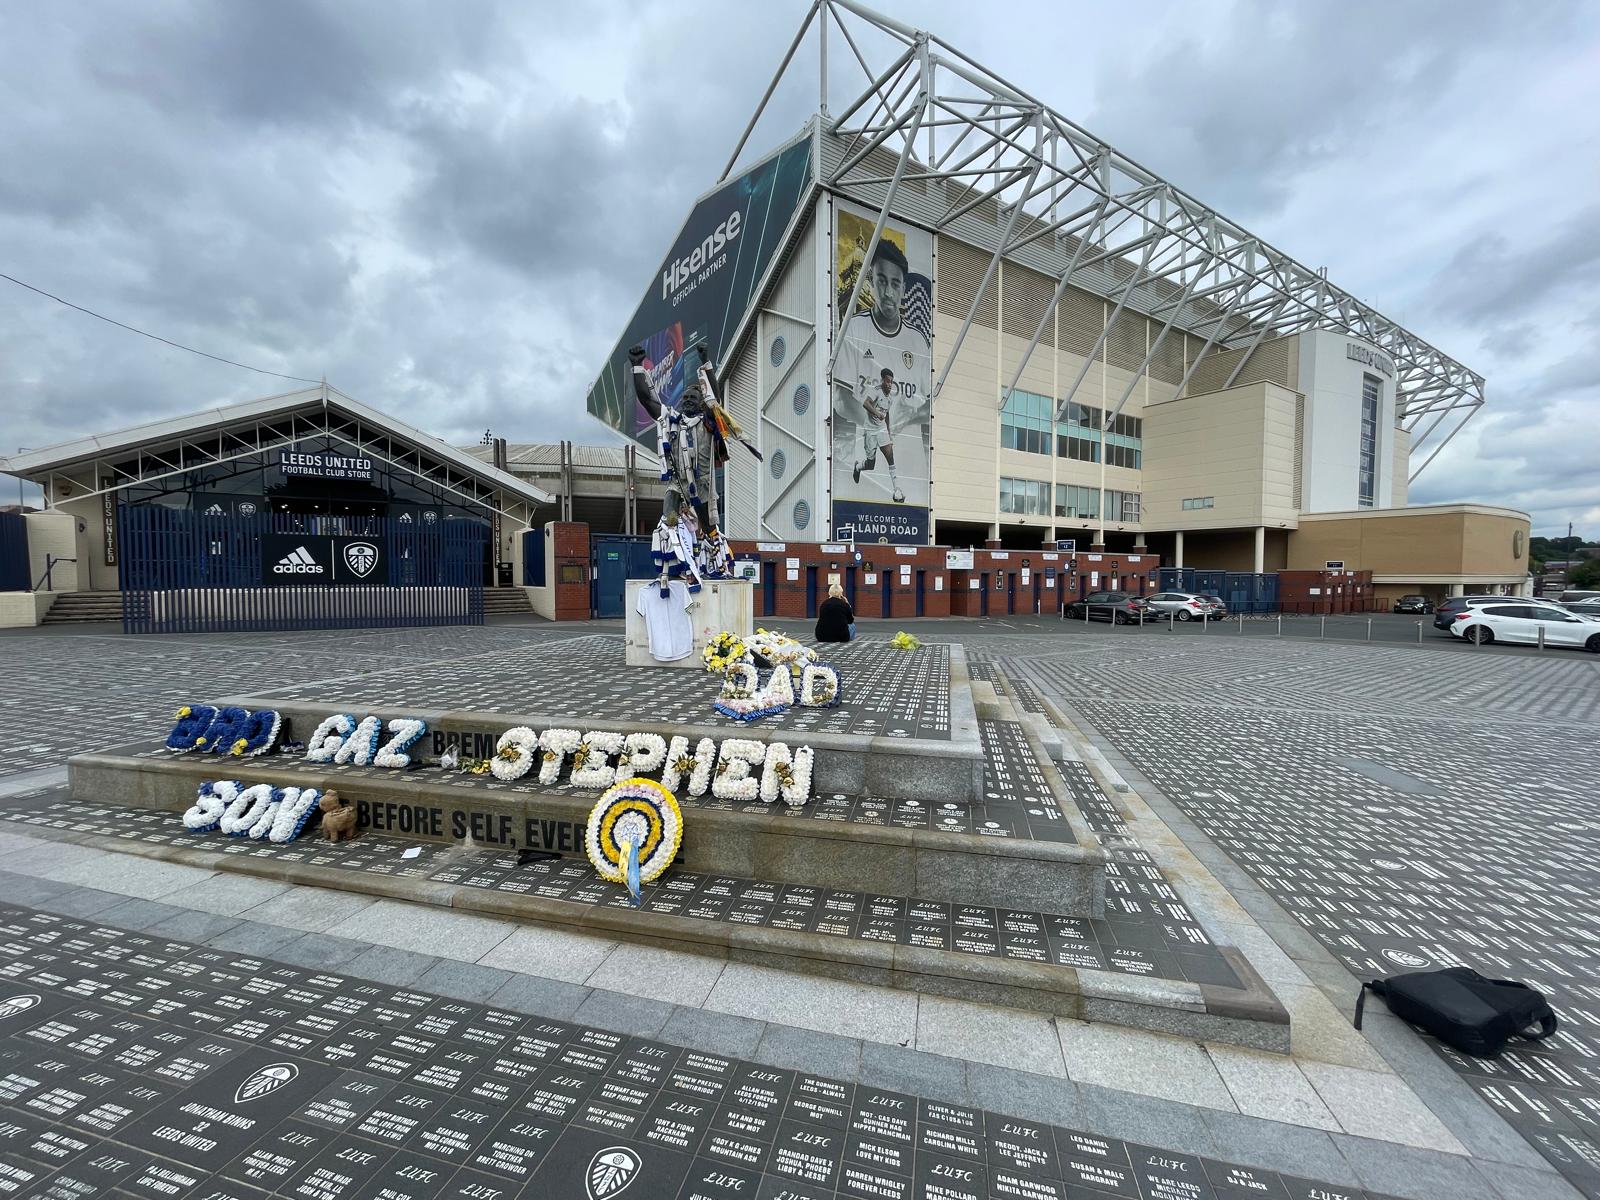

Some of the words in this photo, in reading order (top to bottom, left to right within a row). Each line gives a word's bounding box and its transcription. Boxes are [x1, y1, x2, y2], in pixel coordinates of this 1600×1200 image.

[662, 210, 741, 301] Hisense
[672, 279, 697, 307] OFFICIAL
[698, 253, 727, 285] PARTNER
[281, 453, 322, 466] LEEDS
[325, 456, 371, 470] UNITED
[282, 465, 323, 476] FOOTBALL
[325, 468, 345, 477] CLUB
[347, 470, 371, 479] STORE
[858, 514, 896, 524] WELCOME
[898, 516, 908, 524] TO
[890, 526, 918, 536] ROAD
[105, 518, 114, 563] UNITED
[273, 563, 324, 574] adidas
[306, 713, 427, 768] GAZ
[433, 730, 501, 759] BREM
[490, 726, 815, 806] STEPHEN
[183, 780, 322, 844] SON
[357, 800, 443, 837] BEFORE
[452, 810, 516, 849] SELF,
[636, 1046, 669, 1059] LUFC
[688, 1053, 704, 1062] DAVID
[703, 1057, 729, 1067] PRESTON
[626, 1059, 648, 1070] STUART
[550, 1075, 586, 1089] LUFC
[672, 1073, 699, 1084] ANDREW
[697, 1078, 723, 1090] PRESTON
[747, 1070, 783, 1084] LUFC
[533, 1089, 552, 1099] LEEDS
[549, 1093, 577, 1105] FOREVER
[603, 1083, 632, 1095] STEWART
[733, 1089, 753, 1099] LEEDS
[752, 1093, 778, 1104] FOREVER
[741, 1085, 760, 1094] ALLAN
[759, 1089, 775, 1097] KING
[822, 1089, 846, 1099] ALWAYS
[600, 1090, 616, 1100] KEEP
[614, 1094, 643, 1105] FIGHTING
[793, 1100, 817, 1111] GEORGE
[868, 1095, 905, 1110] LUFC
[179, 1102, 228, 1122] JONATHAN
[450, 1108, 489, 1124] LUFC
[587, 1106, 607, 1117] MICKY
[604, 1111, 636, 1123] JOHNSON
[665, 1101, 704, 1117] LUFC
[809, 1111, 824, 1119] MOT
[956, 1110, 974, 1119] JULIE
[585, 1114, 602, 1124] LUFC
[600, 1118, 613, 1126] FOR
[611, 1121, 627, 1130] LIFE
[654, 1117, 671, 1127] TONY
[676, 1123, 696, 1133] FIONA
[727, 1112, 741, 1120] RAY
[739, 1115, 753, 1123] AND
[753, 1118, 767, 1127] SUE
[727, 1120, 746, 1130] ALAW
[745, 1125, 761, 1133] MOT
[853, 1121, 876, 1133] KIPPER
[152, 1125, 186, 1142] LEEDS
[180, 1133, 217, 1152] UNITED
[509, 1123, 549, 1139] LUFC
[646, 1130, 662, 1139] MOT
[659, 1134, 689, 1147] FOREVER
[655, 1125, 687, 1138] RACKHAM
[926, 1129, 954, 1141] RICHARD
[955, 1136, 976, 1146] MILLS
[1000, 1123, 1040, 1139] LUFC
[791, 1131, 832, 1148] LUFC
[923, 1137, 956, 1151] CAROLINA
[957, 1145, 979, 1156] WHITE
[1084, 1138, 1110, 1149] DANIEL
[335, 1147, 377, 1165] LUFC
[491, 1141, 525, 1156] MARCHING
[523, 1150, 535, 1158] ON
[491, 1150, 524, 1164] TOGETHER
[709, 1145, 743, 1159] MOUNTAIN
[743, 1153, 758, 1163] ASH
[778, 1148, 809, 1162] GRANDAD
[810, 1155, 827, 1166] DAVE
[859, 1142, 876, 1153] MICK
[877, 1147, 900, 1158] ELSOM
[999, 1148, 1012, 1157] LEE
[1012, 1151, 1046, 1165] JEFFREYS
[1023, 1147, 1040, 1157] JACK
[476, 1155, 498, 1166] BRETT
[495, 1159, 527, 1175] CROWDER
[776, 1156, 804, 1169] JOSHUA,
[804, 1162, 831, 1175] PHOEBE
[856, 1150, 873, 1160] LOVE
[873, 1154, 884, 1163] MY
[884, 1156, 901, 1167] KIDS
[1146, 1155, 1188, 1172] LUFC
[313, 1167, 336, 1179] STEVE
[395, 1165, 438, 1184] LUFC
[777, 1164, 796, 1174] LIBBY
[803, 1170, 826, 1182] JESSE
[930, 1163, 973, 1182] LUFC
[1070, 1161, 1096, 1173] SUSAN
[1103, 1169, 1125, 1180] MALC
[703, 1172, 746, 1191] LUFC
[845, 1169, 874, 1182] DARREN
[874, 1176, 906, 1191] WRIGLEY
[997, 1174, 1018, 1186] ADAM
[1019, 1180, 1056, 1195] GARWOOD
[1080, 1172, 1119, 1188] HARGRAVE
[847, 1179, 878, 1194] FOREVER
[879, 1187, 901, 1200] LEEDS
[925, 1183, 944, 1195] MIKE
[945, 1188, 977, 1200] POLLARD
